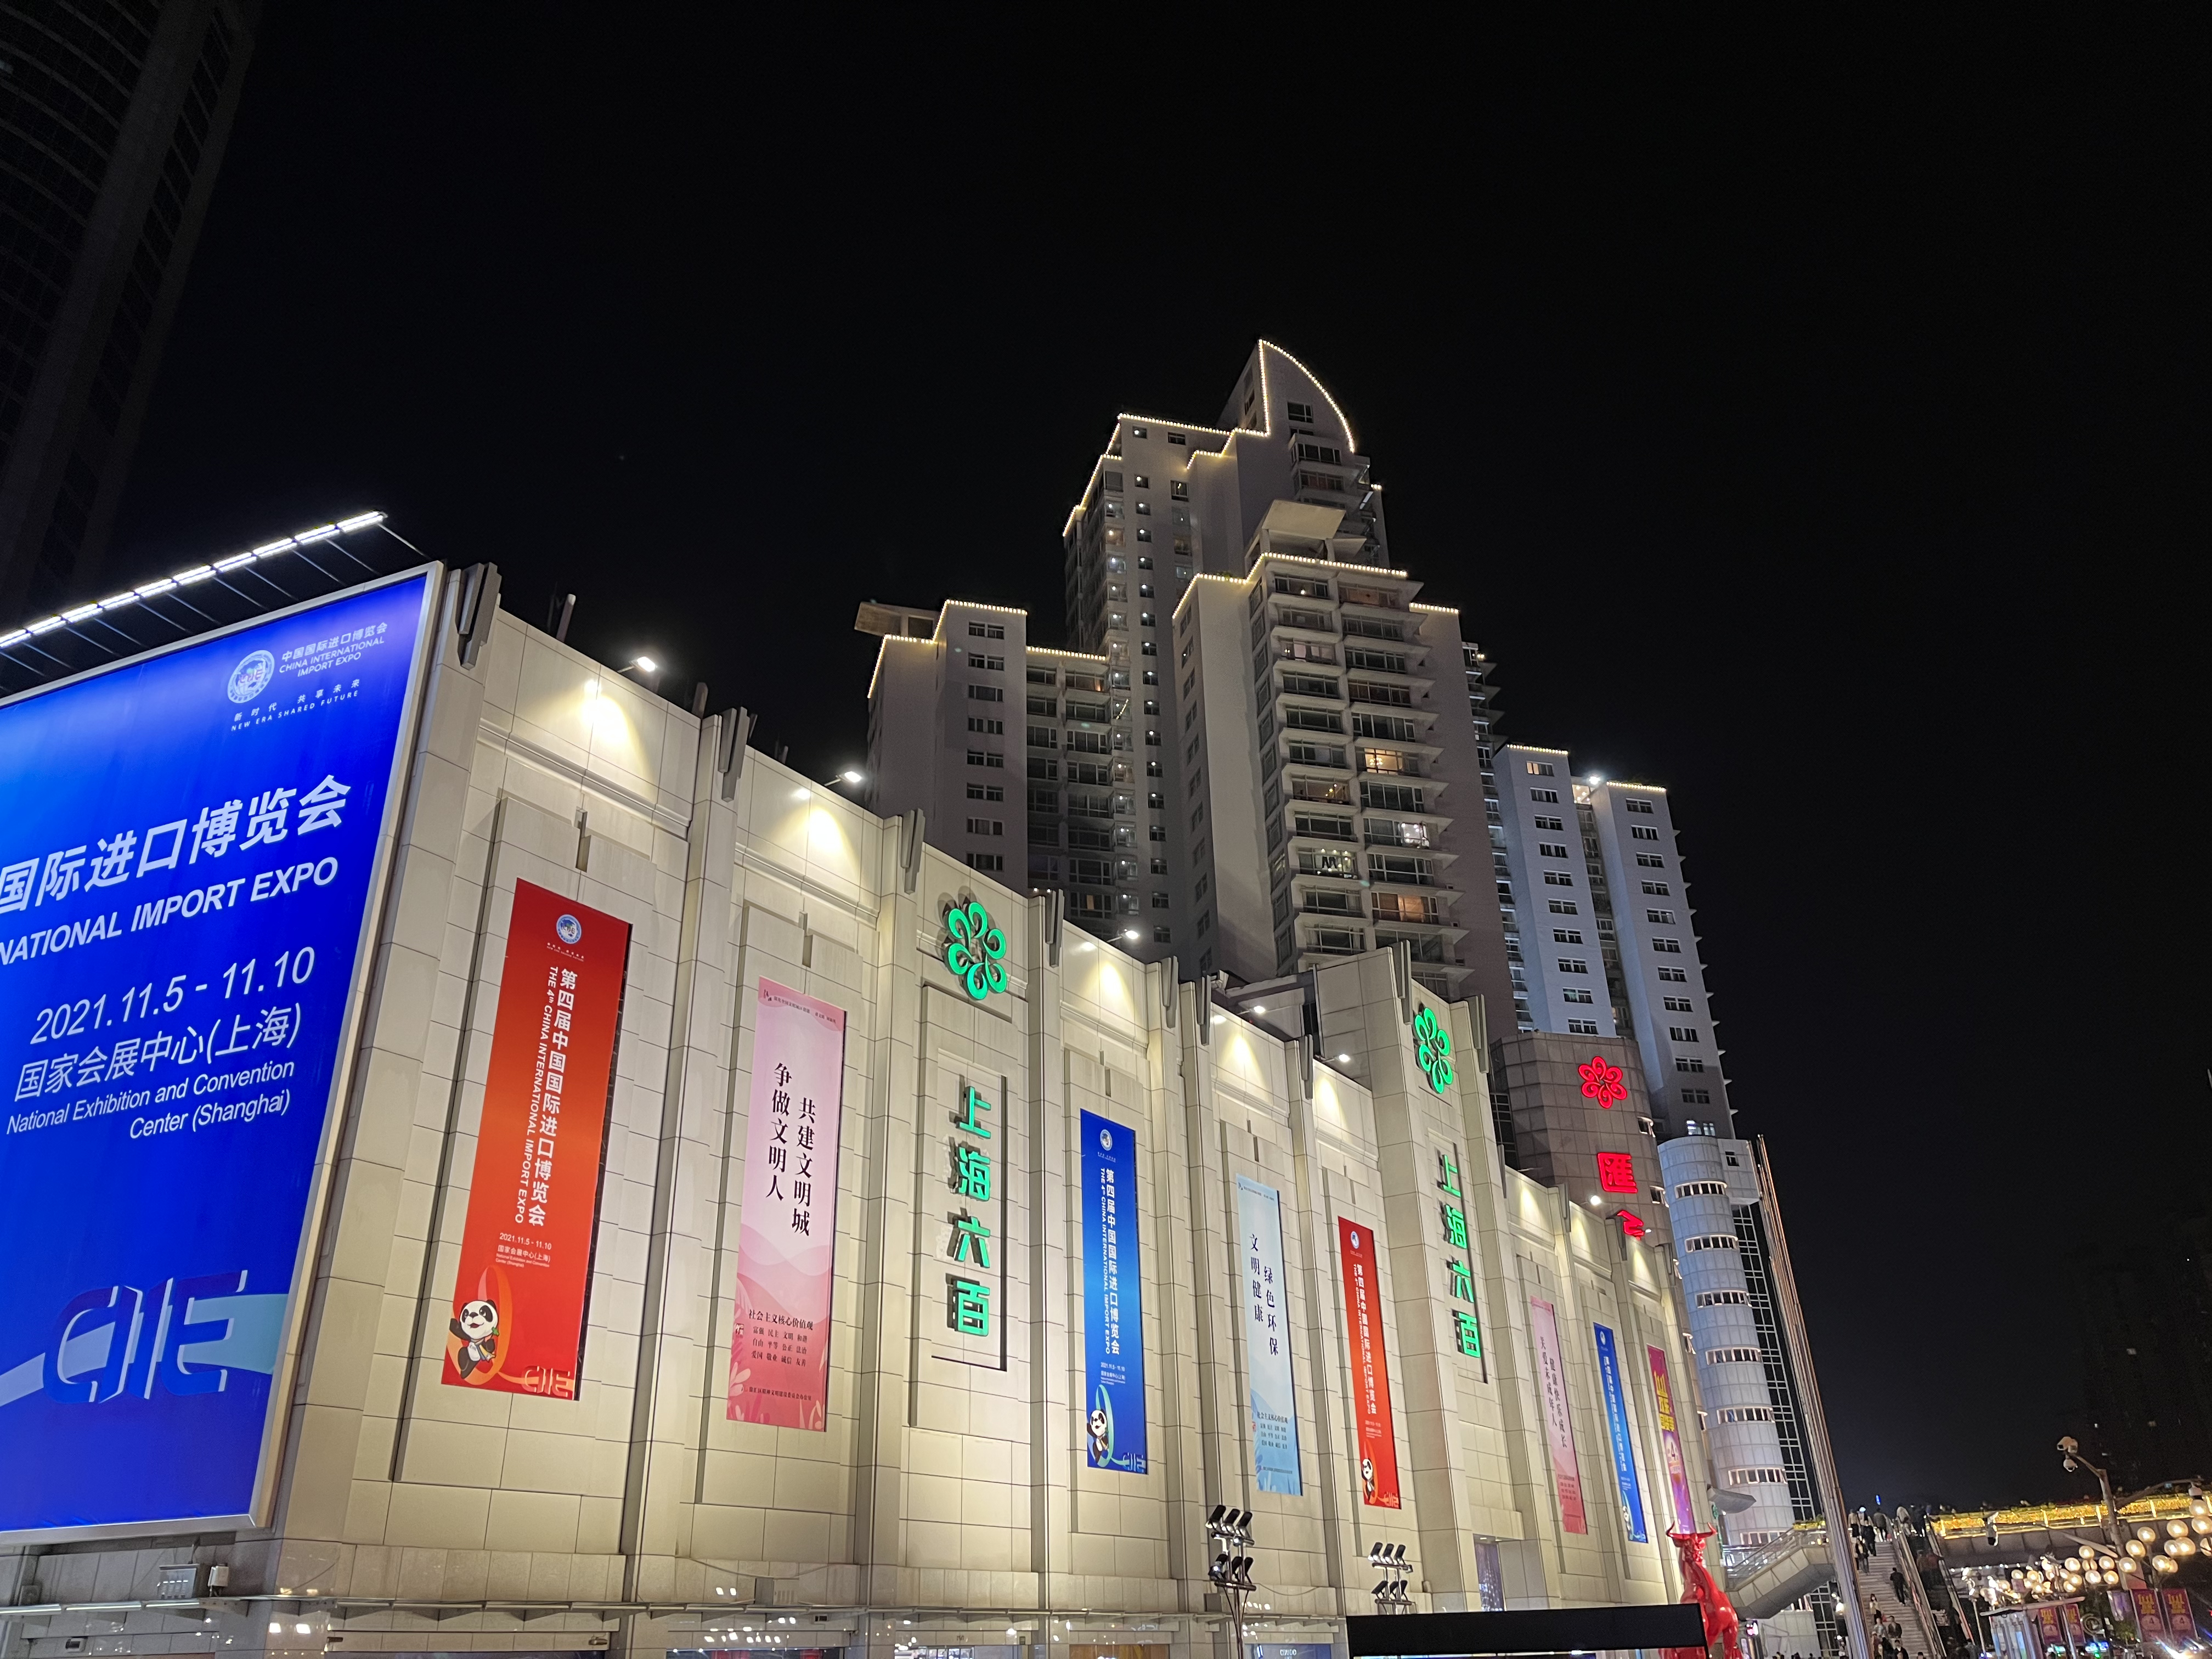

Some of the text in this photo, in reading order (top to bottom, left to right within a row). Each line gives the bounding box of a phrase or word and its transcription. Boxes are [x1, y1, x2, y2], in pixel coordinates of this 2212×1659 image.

[279, 636, 385, 673] CHINA INTERNATIONAL
[281, 622, 388, 662] 中国国际进口博览会
[297, 652, 362, 677] IMPORT EXPO
[231, 690, 358, 731] NEW ERA SHARED FUTURE
[0, 774, 352, 914] 国际进口博览会
[0, 856, 338, 966] NATIONAL IMPORT EXPO
[30, 975, 187, 1045] 2021.11.5
[222, 946, 315, 998] 11.10
[548, 966, 558, 988] THE
[14, 1002, 301, 1102] 国家会展中心(上海)
[539, 1005, 553, 1040] CHINA
[7, 1060, 295, 1135] National Exhibition and Convention
[129, 1088, 291, 1139] Center (Shanghai)
[526, 1042, 548, 1136] INTERNATIONAL
[528, 968, 578, 1228] 第四届中国国际进口博览会
[519, 1139, 534, 1187] IMPORT
[766, 1062, 792, 1201] 争做文明人
[792, 1097, 816, 1237] 共建文明城
[499, 1232, 530, 1245] 2021.11.5
[536, 1240, 552, 1250] 11.10
[515, 1189, 528, 1224] EXPO
[955, 1085, 991, 1336] 上海六百
[1106, 1168, 1120, 1355] 第四届中国国际进口博览会
[1249, 1233, 1263, 1322] 文明健康
[1442, 1154, 1481, 1358] 上海六百
[749, 1309, 813, 1331] 社会主义核心价值观
[783, 1331, 793, 1340] 文明
[1264, 1266, 1278, 1356] 绿色环保
